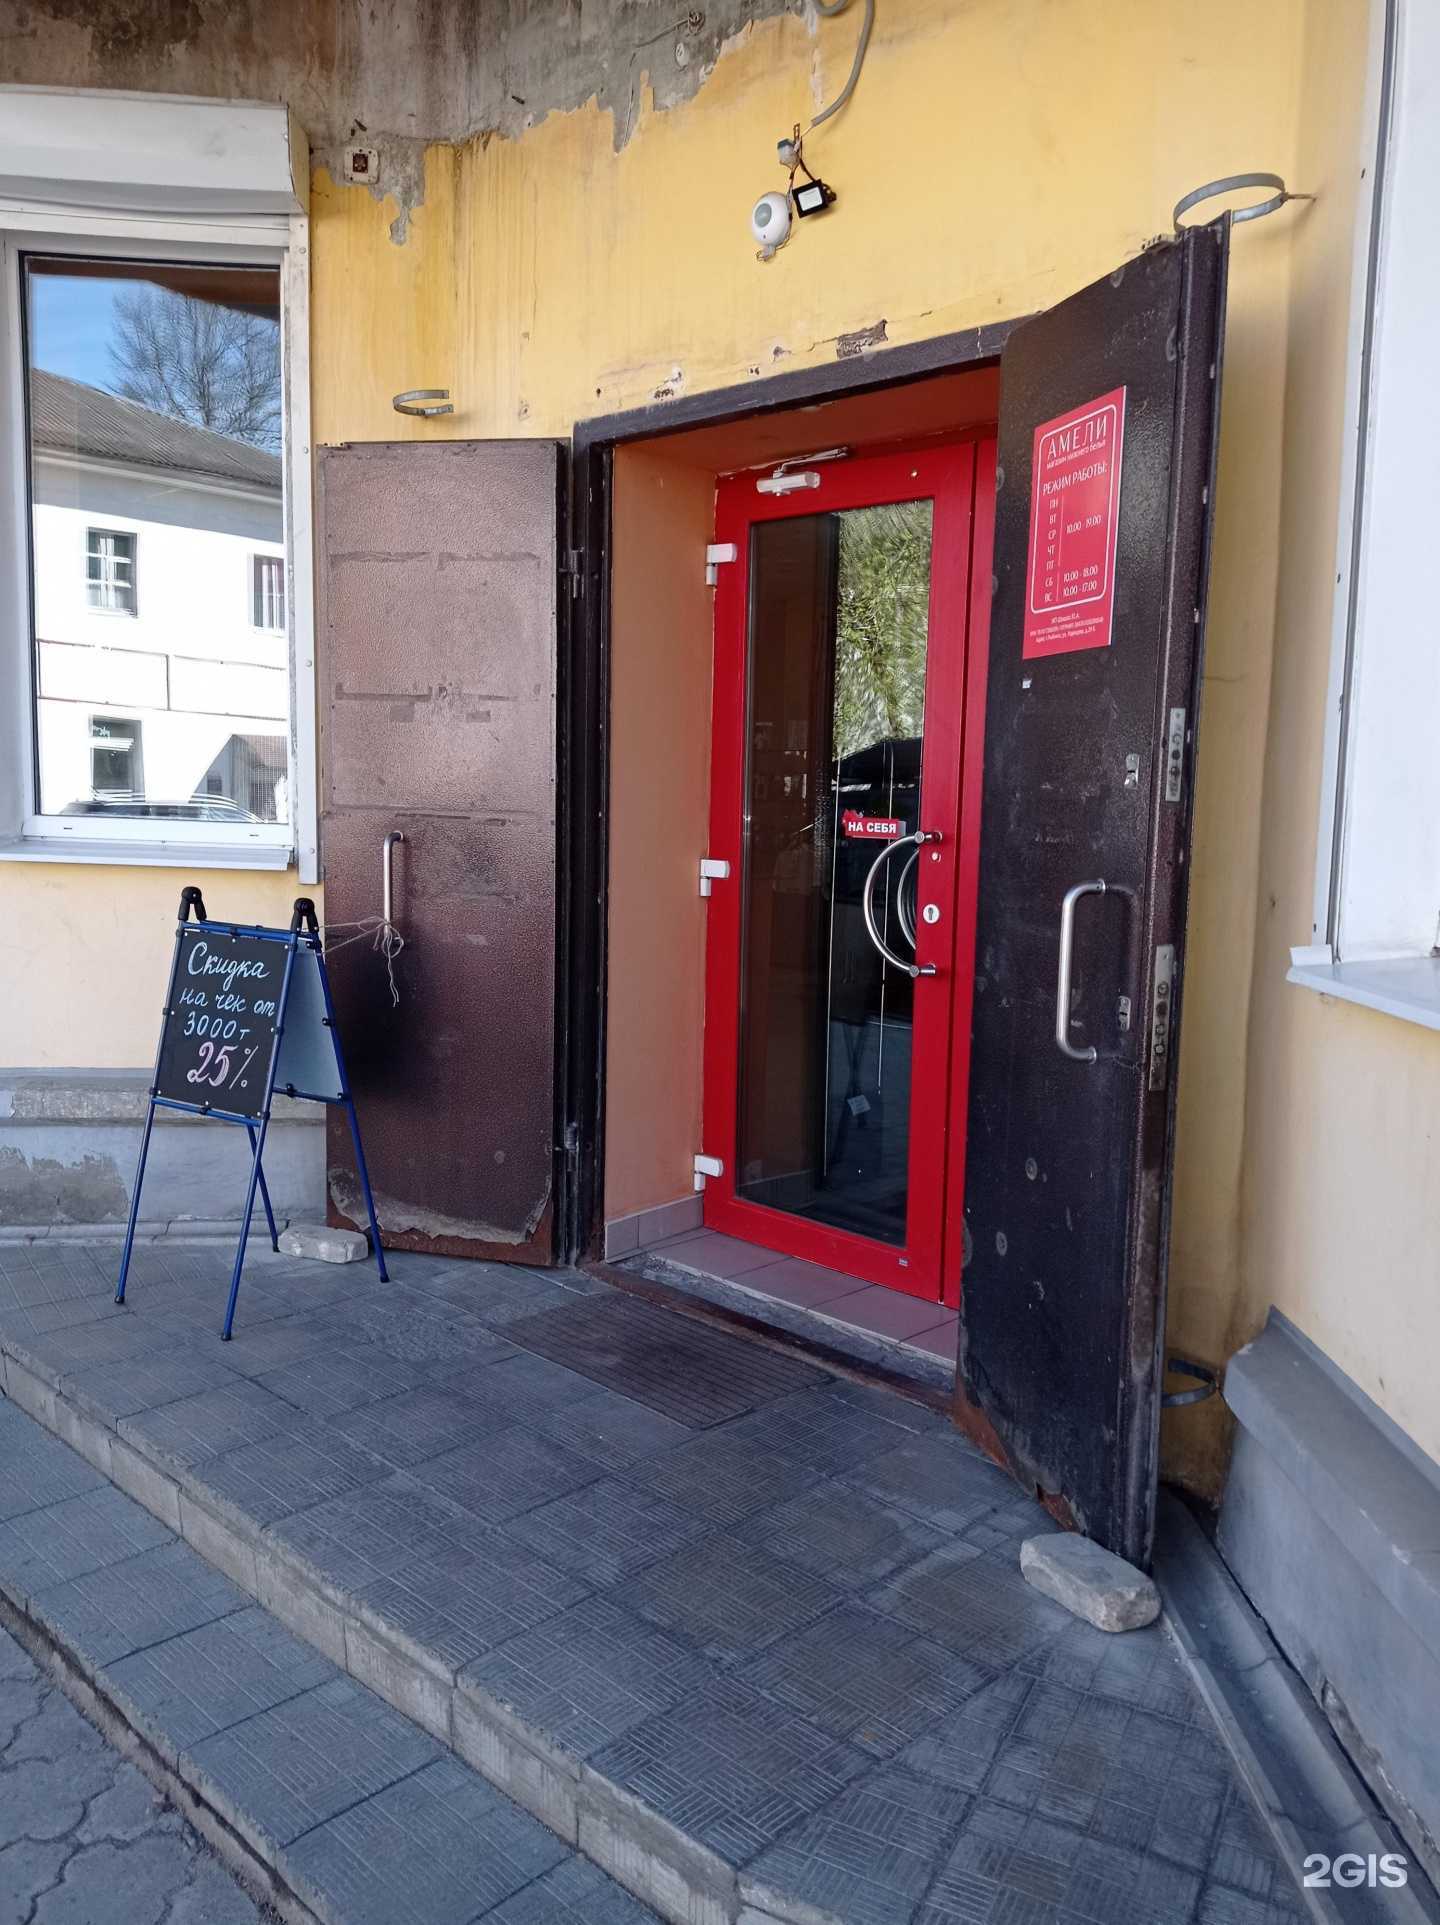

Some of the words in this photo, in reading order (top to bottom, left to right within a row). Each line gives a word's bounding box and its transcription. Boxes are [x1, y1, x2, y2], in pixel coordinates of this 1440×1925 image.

[1047, 415, 1107, 460] АМЕЛИ
[1043, 474, 1071, 496] РЕЖИМ
[1072, 462, 1108, 484] РАБОТЫ:
[1049, 498, 1058, 510] ПН
[1049, 513, 1056, 524] ВТ
[1048, 529, 1057, 540] СР
[1047, 544, 1055, 555] ЧТ
[1046, 560, 1054, 571] ПТ
[1045, 577, 1053, 587] СБ
[1044, 591, 1053, 602] ВС
[848, 821, 863, 832] НА
[866, 822, 897, 833] СЕБЯ
[187, 941, 270, 991] Скидка
[178, 987, 208, 1007] на
[215, 993, 247, 1012] чек
[253, 1000, 276, 1017] от
[186, 1041, 259, 1090] 25%
